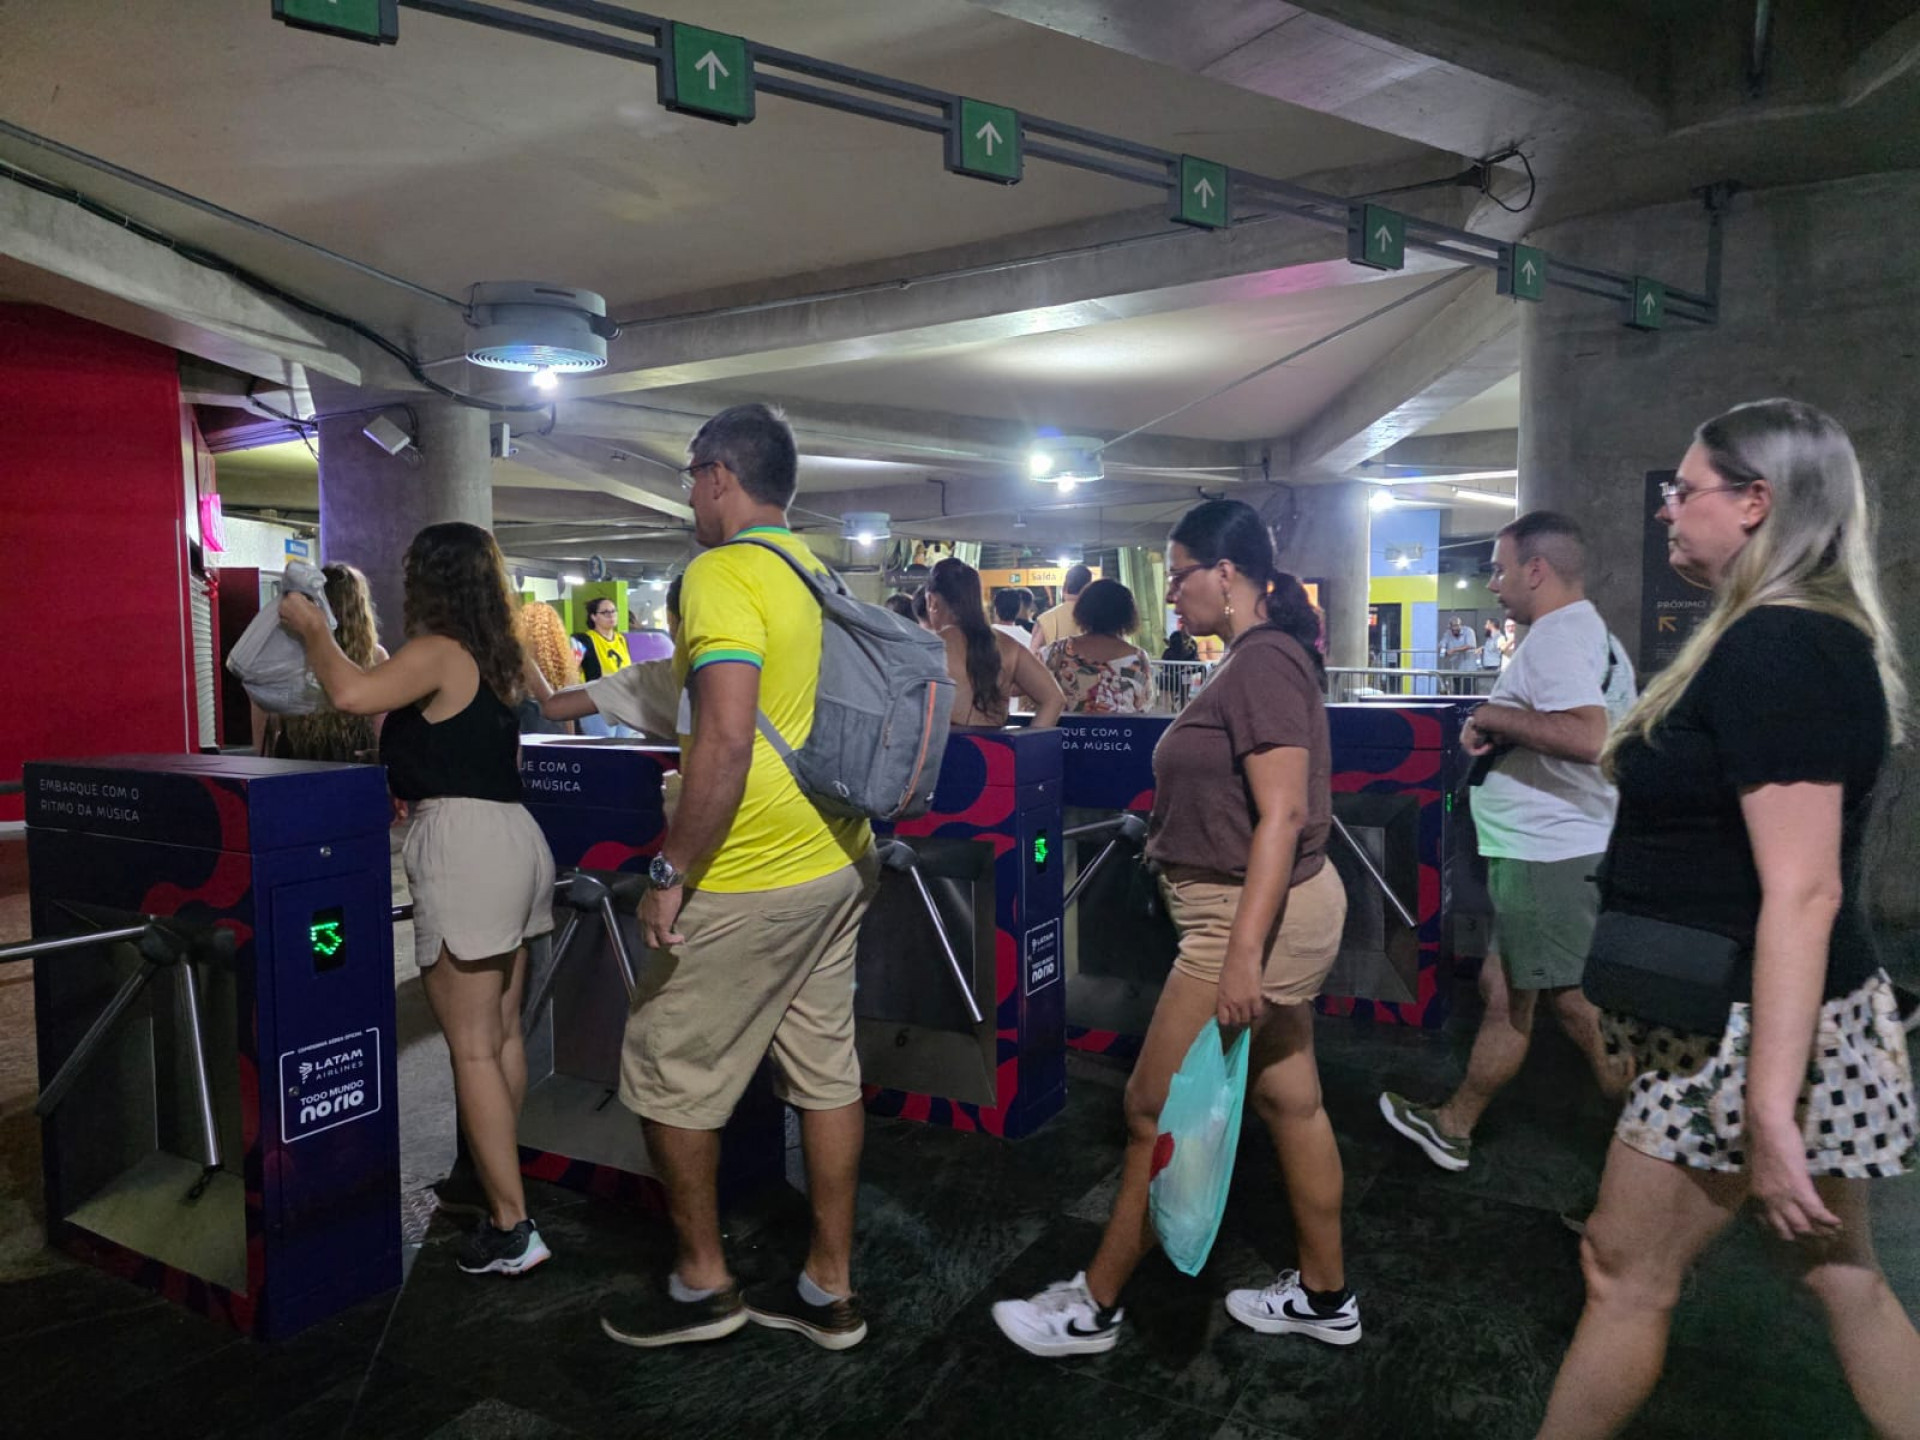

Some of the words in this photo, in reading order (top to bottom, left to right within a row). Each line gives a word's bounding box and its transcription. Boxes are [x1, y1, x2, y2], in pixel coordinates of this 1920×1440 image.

[1091, 727, 1118, 738] COM
[1123, 728, 1133, 738] O
[1062, 740, 1079, 750] DA
[1083, 739, 1132, 751] MÚSICA
[538, 761, 567, 774] COM
[571, 762, 581, 774] O
[39, 778, 99, 796] EMBARQUE
[101, 785, 127, 799] COM
[130, 787, 140, 801] O
[530, 776, 581, 792] MÚSICA
[40, 799, 75, 815] RITMO
[77, 803, 93, 817] DA
[894, 1026, 910, 1048] 6
[315, 1048, 363, 1071] LATAM
[316, 1060, 364, 1080] AIRLINES
[300, 1090, 328, 1106] TODO
[329, 1079, 365, 1098] MUNDO
[595, 1088, 616, 1112] 7
